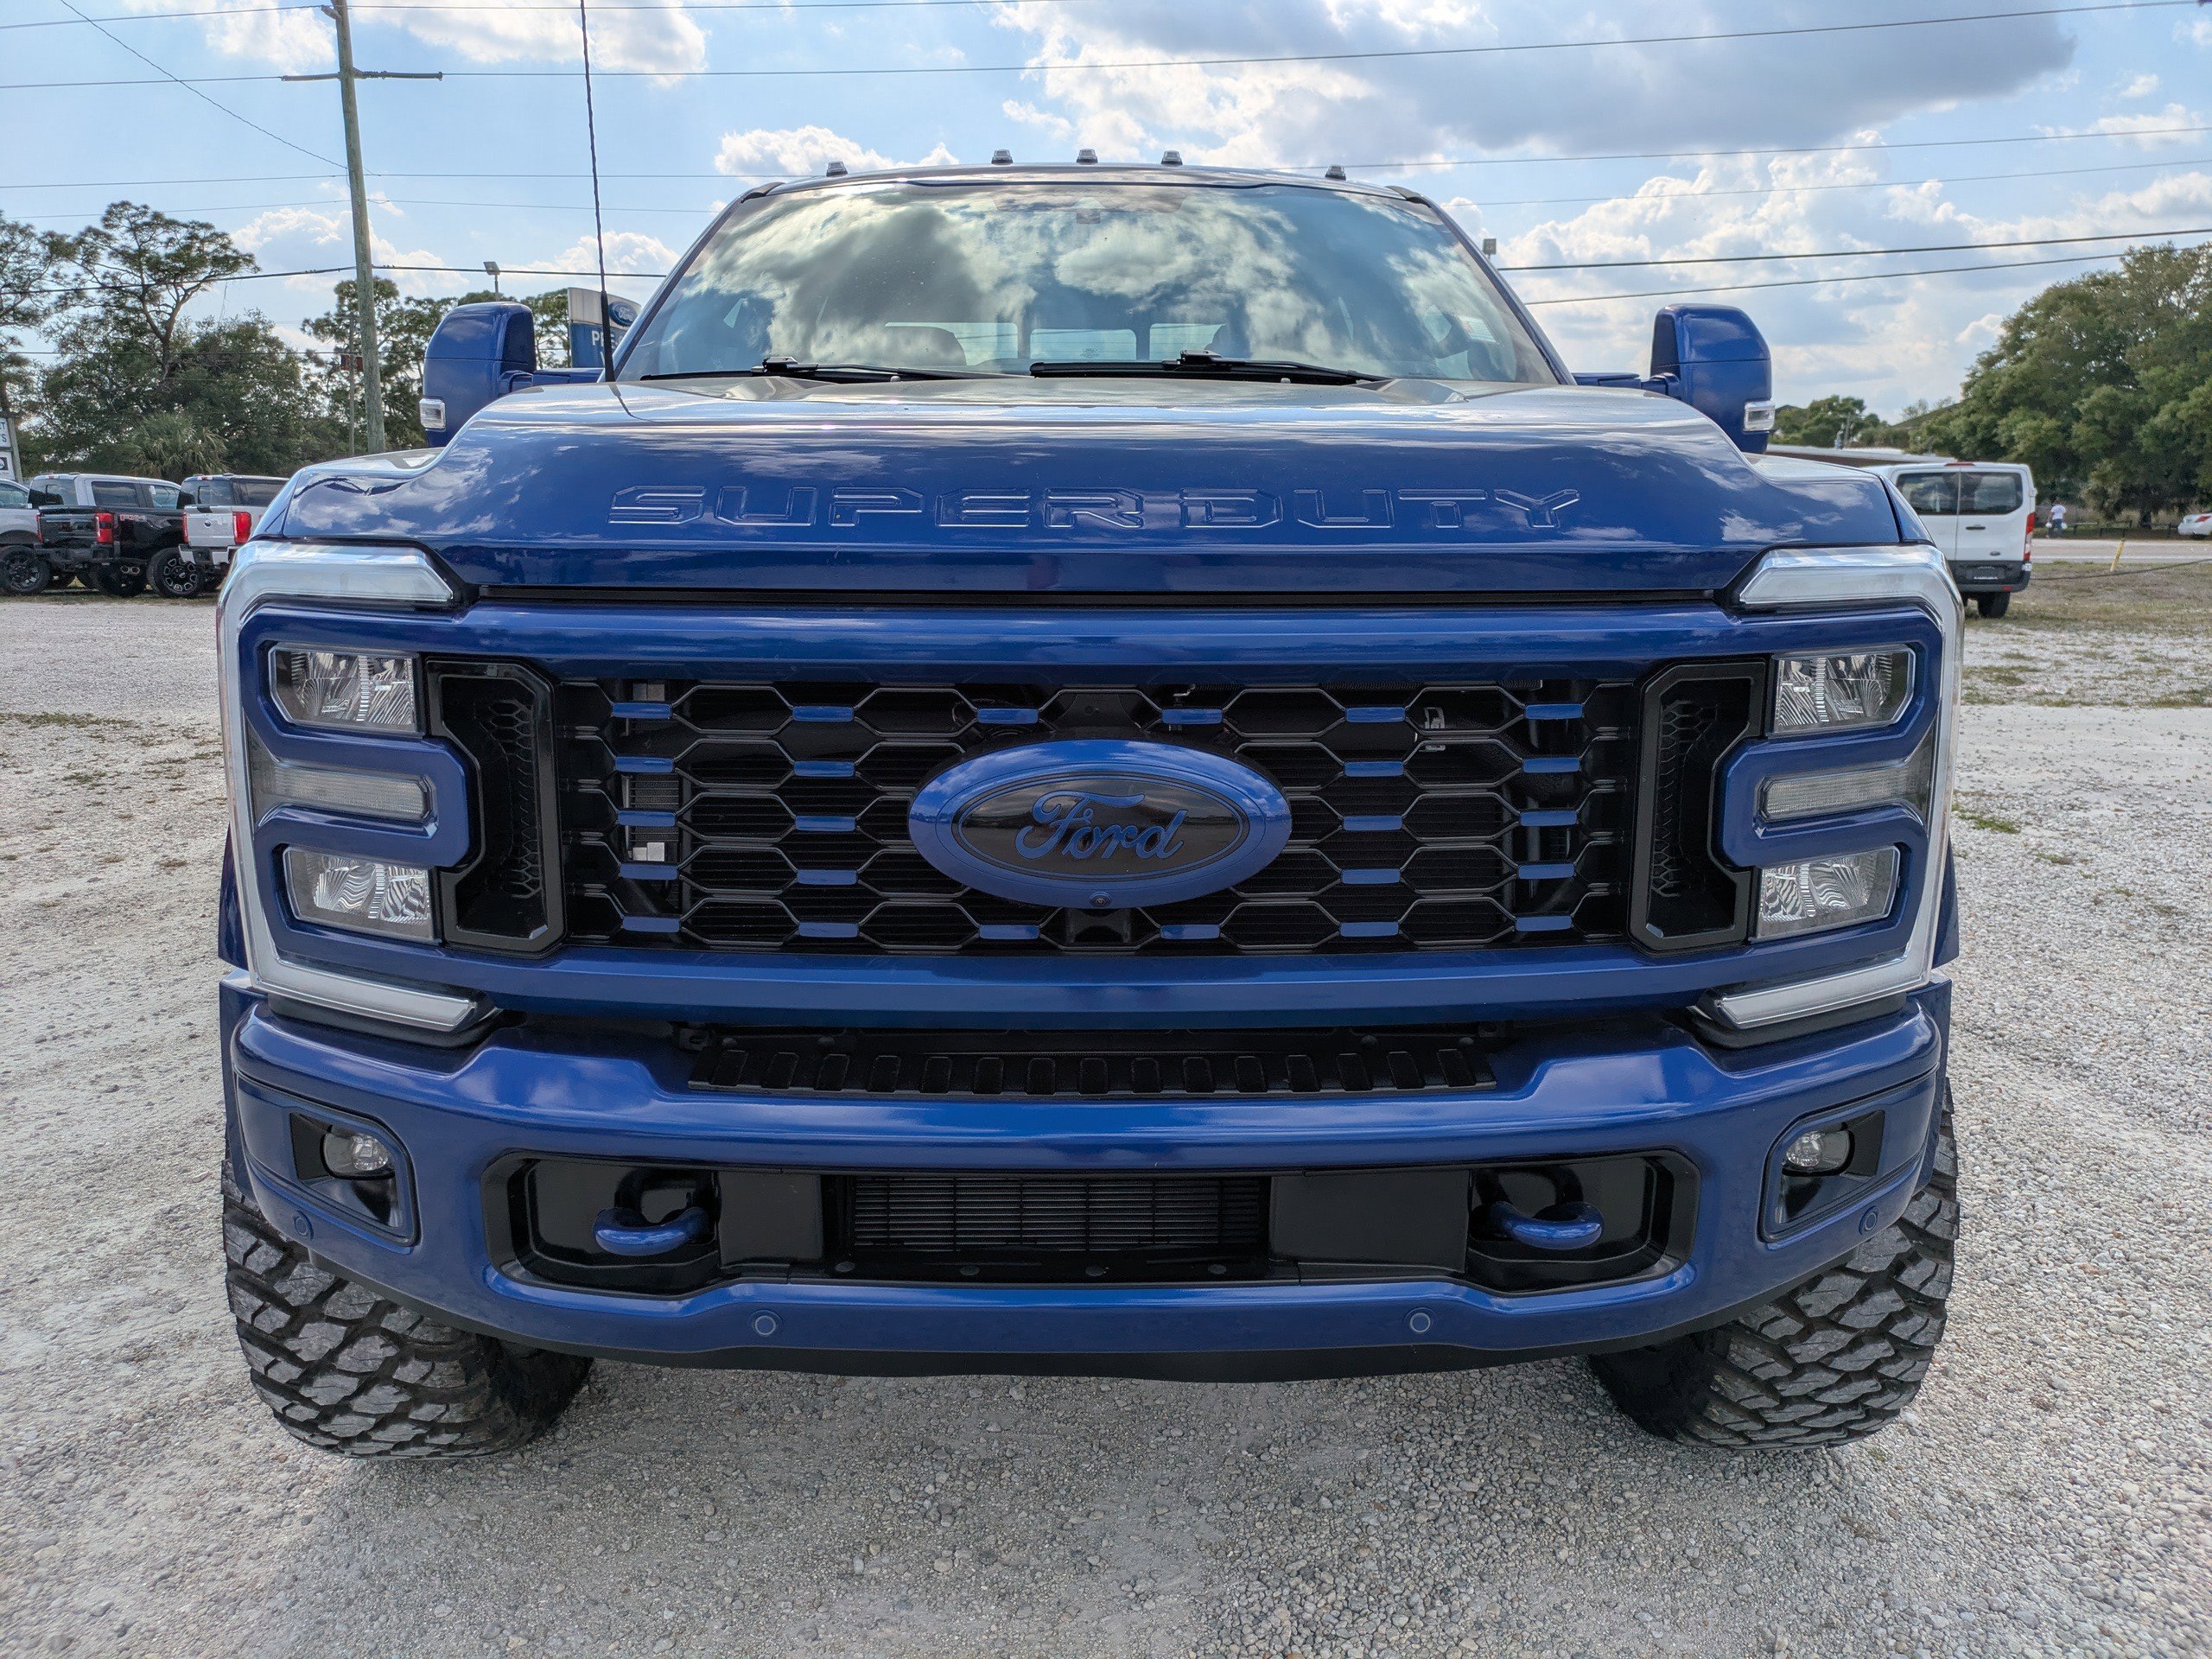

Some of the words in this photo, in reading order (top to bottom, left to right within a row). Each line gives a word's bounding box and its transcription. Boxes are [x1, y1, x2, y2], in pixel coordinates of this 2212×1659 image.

[607, 485, 1144, 529] SUPER
[1179, 487, 1581, 529] DUTY
[1014, 789, 1189, 860] Ford
